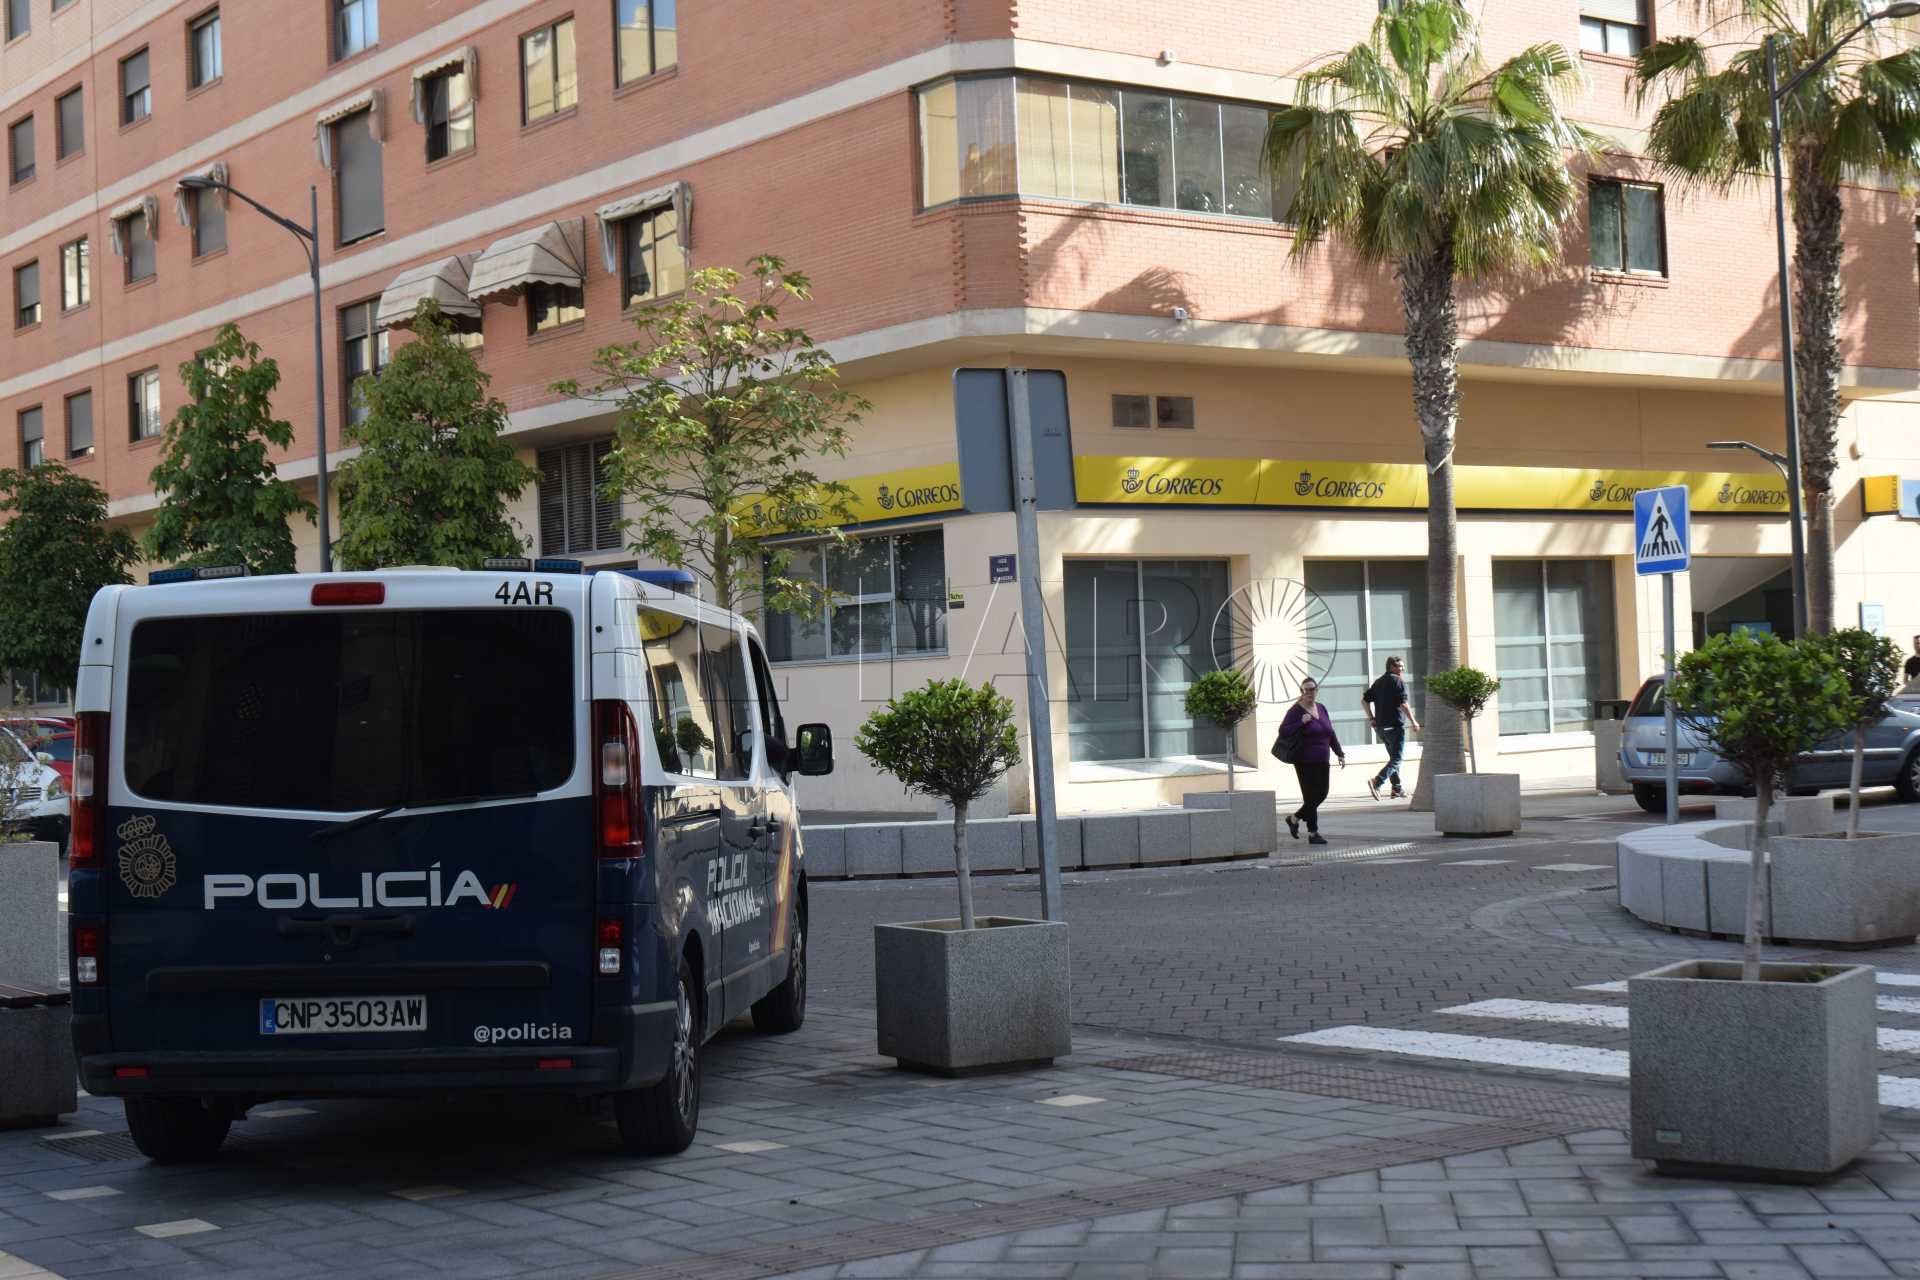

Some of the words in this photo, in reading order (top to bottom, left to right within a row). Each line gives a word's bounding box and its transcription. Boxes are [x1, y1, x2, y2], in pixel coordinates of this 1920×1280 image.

[896, 483, 959, 509] CORREOS
[1145, 473, 1223, 496] CORREOS
[1315, 476, 1386, 498] CORREOS
[1734, 486, 1786, 505] CORREOS
[494, 581, 554, 605] 4AR
[203, 860, 492, 910] POLICÍA
[474, 1022, 572, 1043] @policia
